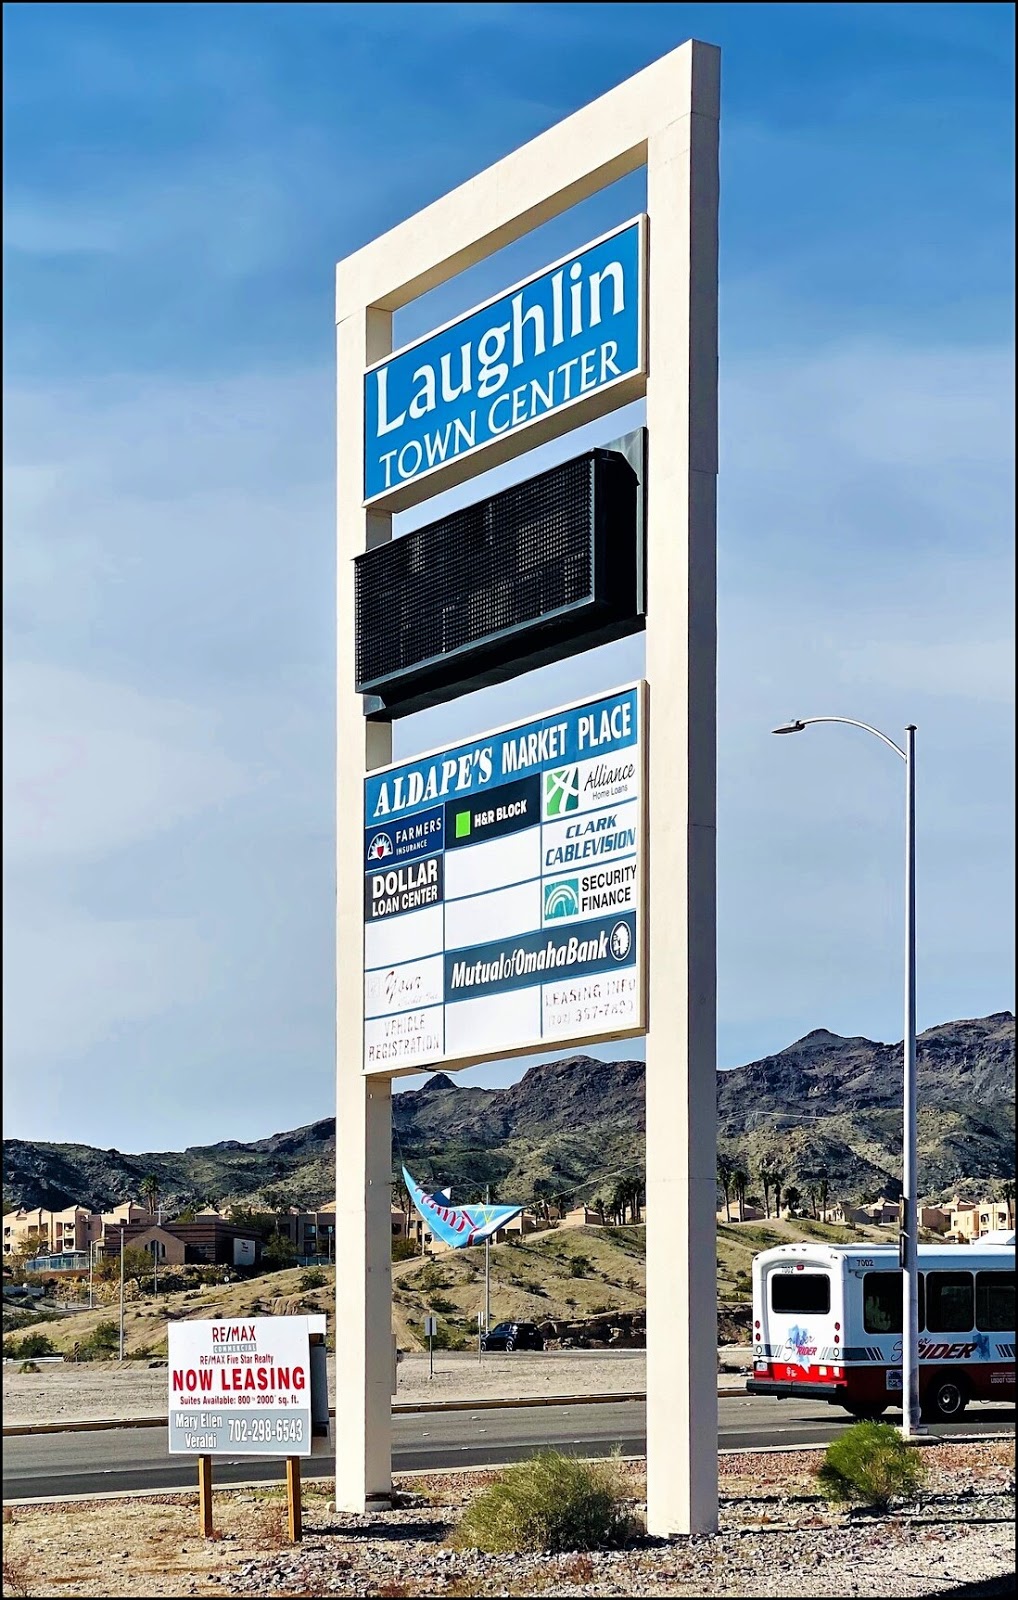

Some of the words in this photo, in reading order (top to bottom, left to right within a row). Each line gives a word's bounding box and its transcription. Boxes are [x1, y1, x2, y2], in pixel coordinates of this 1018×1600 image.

[376, 261, 625, 437] Laughlin
[379, 410, 476, 488] TOWN
[488, 340, 621, 434] CENTER
[373, 746, 493, 818] ALDAPE'S
[502, 722, 568, 775] MARKET
[578, 702, 631, 750] PLACE
[584, 763, 635, 791] Alliance
[592, 789, 610, 801] Home
[611, 784, 628, 796] Loans
[474, 811, 495, 828] H&R
[496, 799, 527, 822] BLOCK
[396, 817, 442, 843] FARMERS
[565, 814, 617, 839] CLARK
[396, 839, 428, 856] INSURANCE
[545, 827, 636, 867] CABLEVISION
[372, 859, 438, 899] DOLLAR
[581, 864, 636, 892] SECURITY
[372, 896, 400, 917] LOAN
[401, 884, 438, 910] CENTER
[581, 887, 631, 912] FINANCE
[546, 984, 602, 1007] LEASING
[384, 1014, 425, 1037] VEHICLE
[368, 1034, 440, 1062] REGISTRATION
[857, 1259, 874, 1267] 7002
[212, 1325, 256, 1342] RE/MAX
[200, 1355, 225, 1365] RE/MAX
[227, 1354, 239, 1365] Five
[240, 1354, 253, 1364] Star
[254, 1353, 274, 1366] Realty
[214, 1344, 256, 1353] COMMERCIAL
[173, 1369, 213, 1391] NOW
[221, 1366, 305, 1391] LEASING
[180, 1395, 201, 1405] Suites
[203, 1395, 236, 1405] Available:
[238, 1395, 251, 1405] 800
[278, 1395, 289, 1406] sq.
[291, 1394, 300, 1404] ft.
[175, 1412, 198, 1430] Mary
[200, 1411, 223, 1429] Ellen
[228, 1418, 303, 1443] 702-298-6543
[185, 1432, 217, 1449] Veraldi
